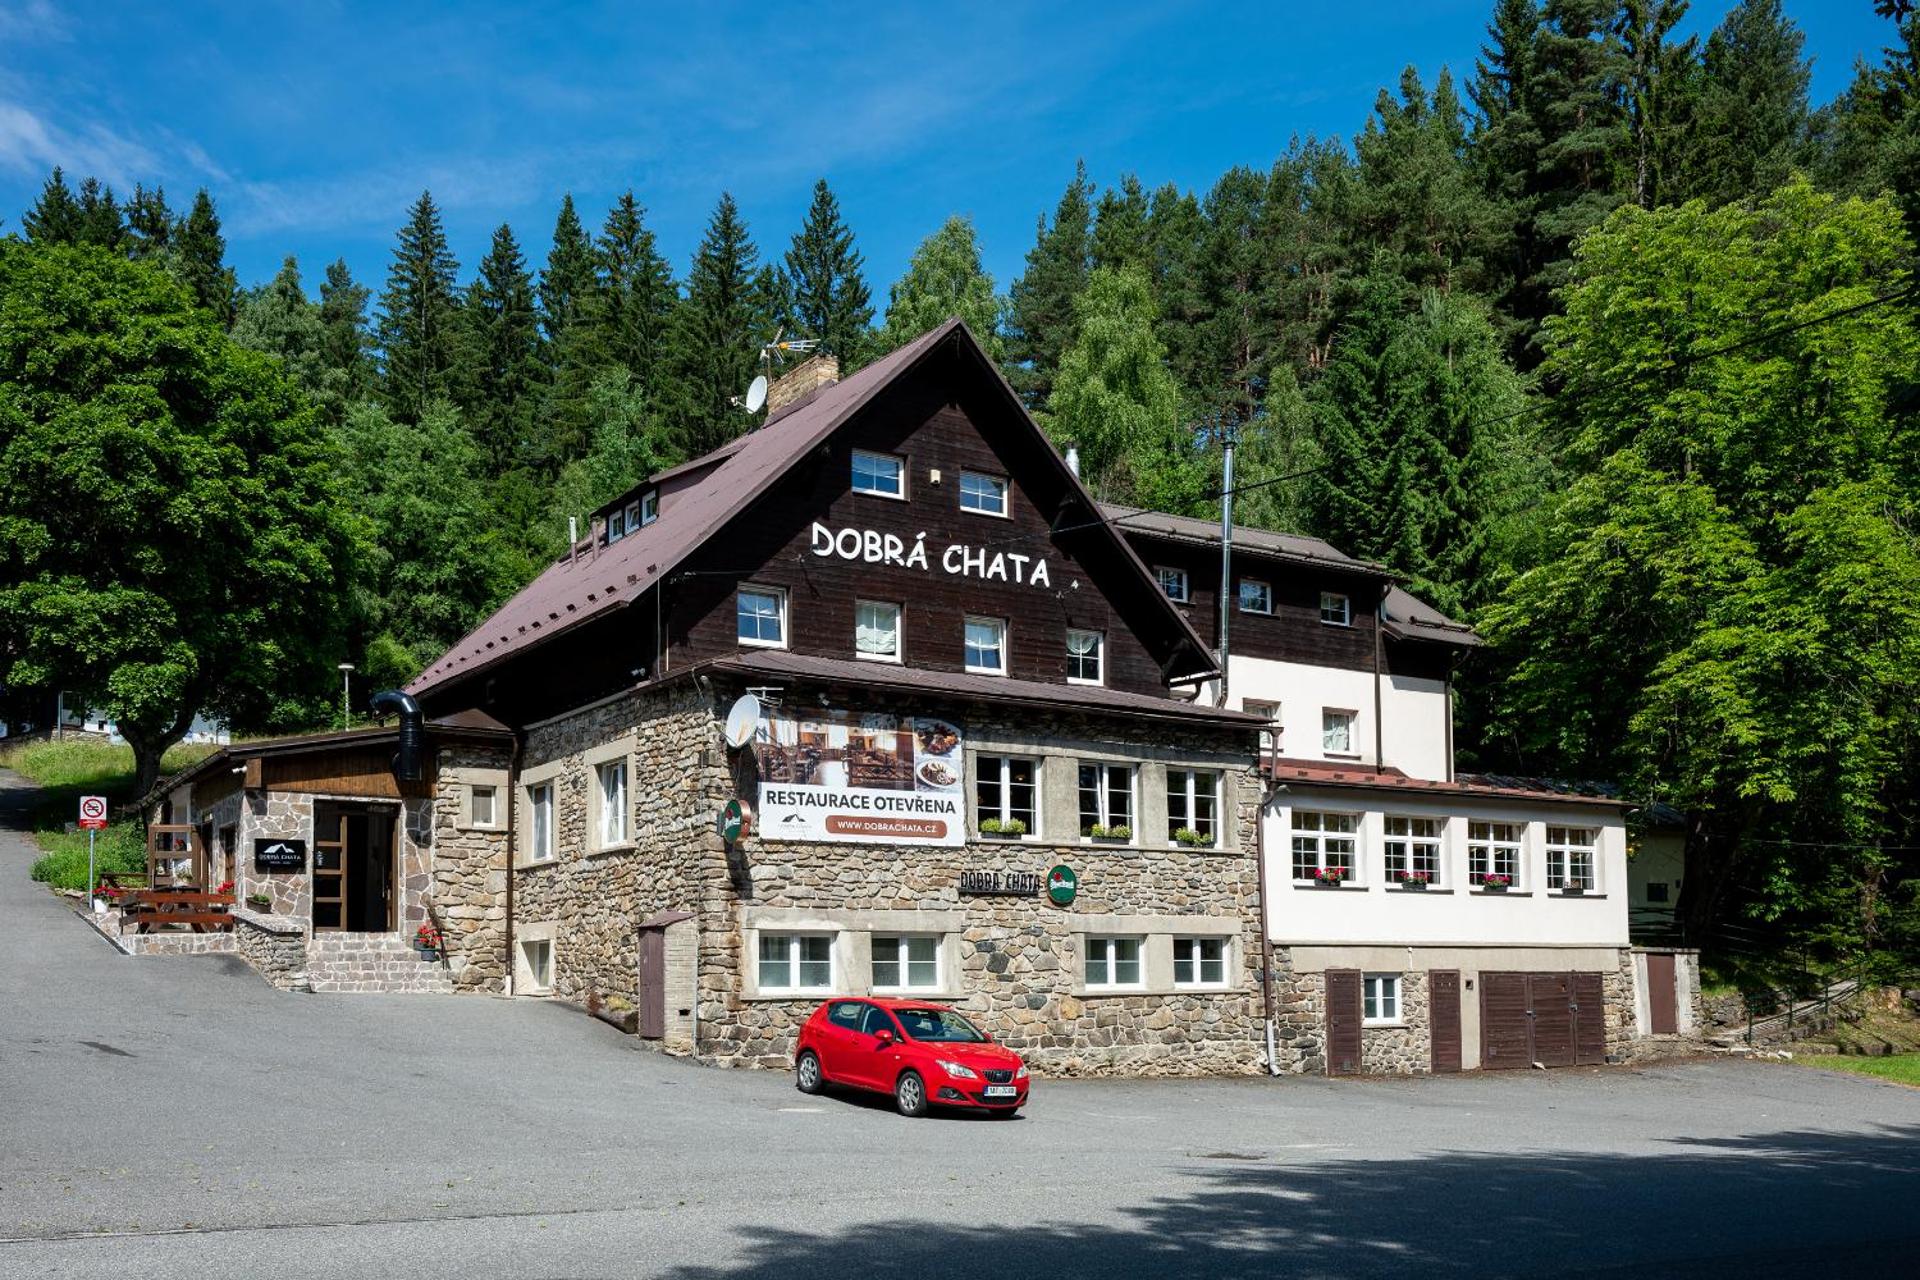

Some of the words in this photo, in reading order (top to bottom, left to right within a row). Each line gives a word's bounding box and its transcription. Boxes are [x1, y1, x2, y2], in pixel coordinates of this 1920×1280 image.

[811, 521, 929, 570] DOBRÁ
[943, 545, 1050, 588] CHATA
[766, 790, 870, 810] RESTAURACE
[873, 795, 957, 814] OTEVŘENA
[837, 820, 938, 834] WWW.DOBRACHATA.CZ
[1005, 872, 1040, 892] CHATA
